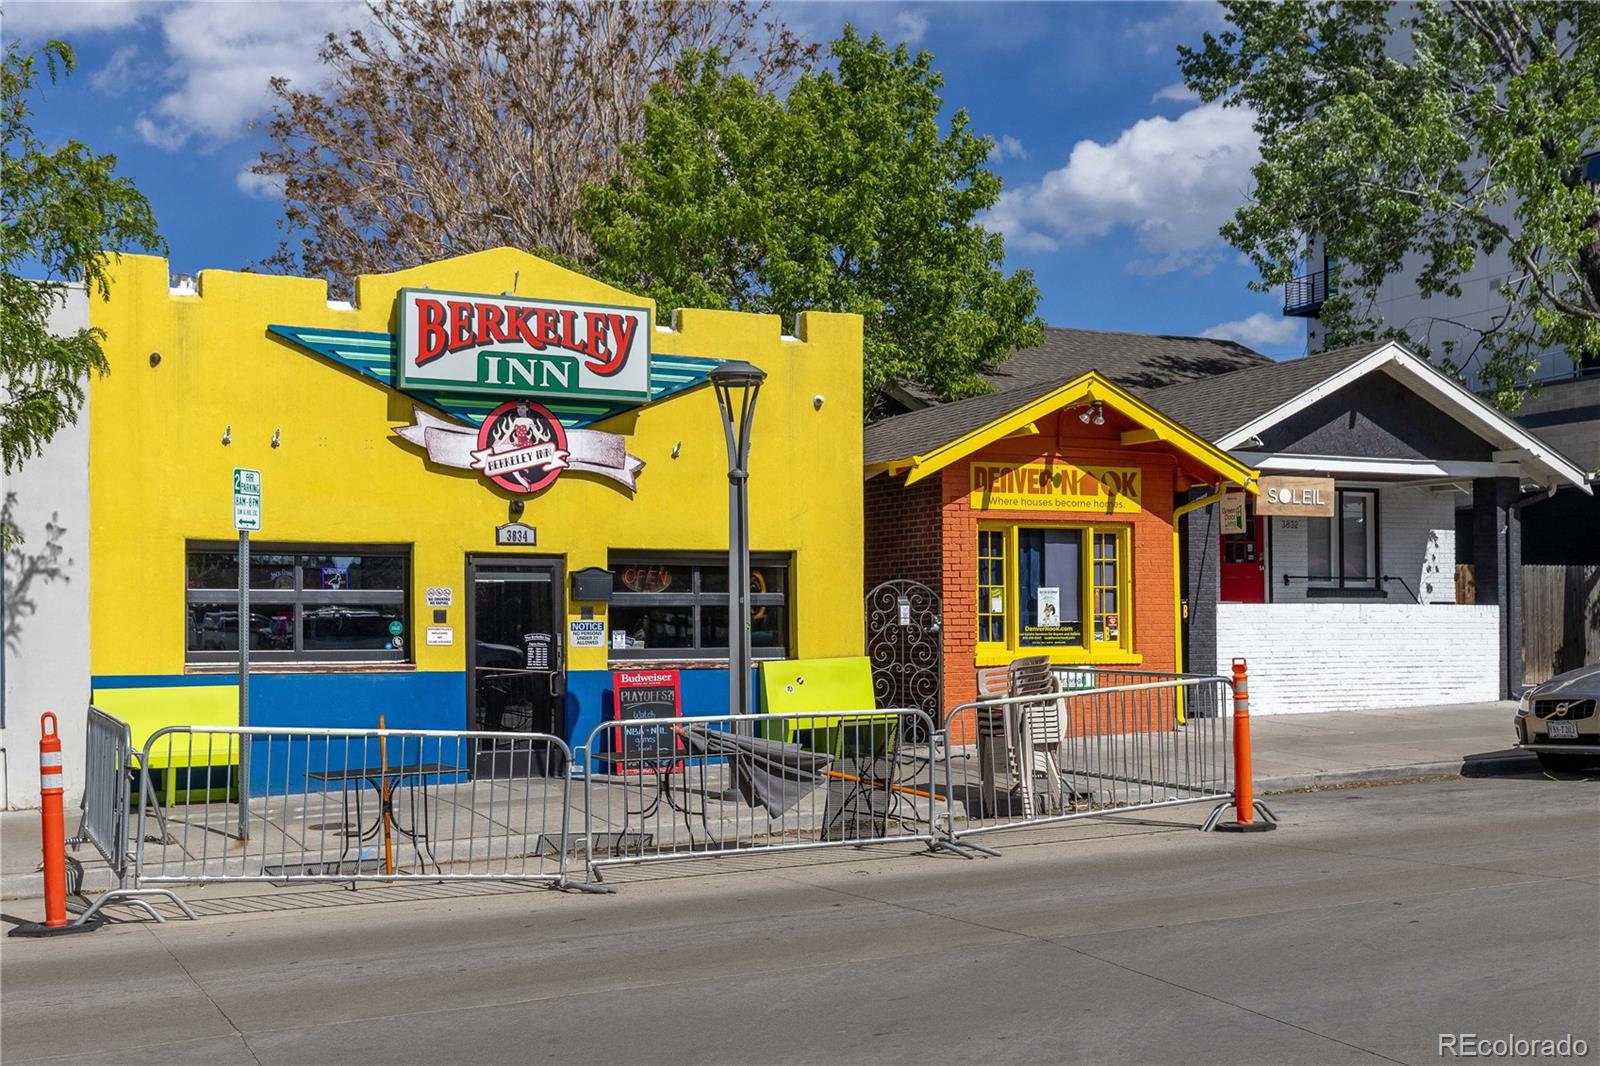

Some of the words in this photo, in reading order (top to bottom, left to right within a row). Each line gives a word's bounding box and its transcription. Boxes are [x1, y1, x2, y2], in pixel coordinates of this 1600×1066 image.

[415, 298, 639, 377] BERKELEY
[484, 356, 572, 388] INN
[488, 451, 533, 472] BERKELEY
[535, 447, 552, 460] INN
[235, 473, 240, 490] 2
[246, 473, 255, 482] HR
[241, 483, 260, 493] PARKING
[1267, 487, 1326, 505] SOLEIL
[990, 497, 1019, 506] Where
[1021, 497, 1053, 507] houses
[1055, 499, 1091, 508] become
[1093, 499, 1126, 509] homes.
[1281, 520, 1299, 529] 3832
[506, 529, 529, 543] 3834
[572, 622, 603, 630] NOTICE
[621, 673, 672, 683] Budweiser
[625, 726, 644, 735] NBA
